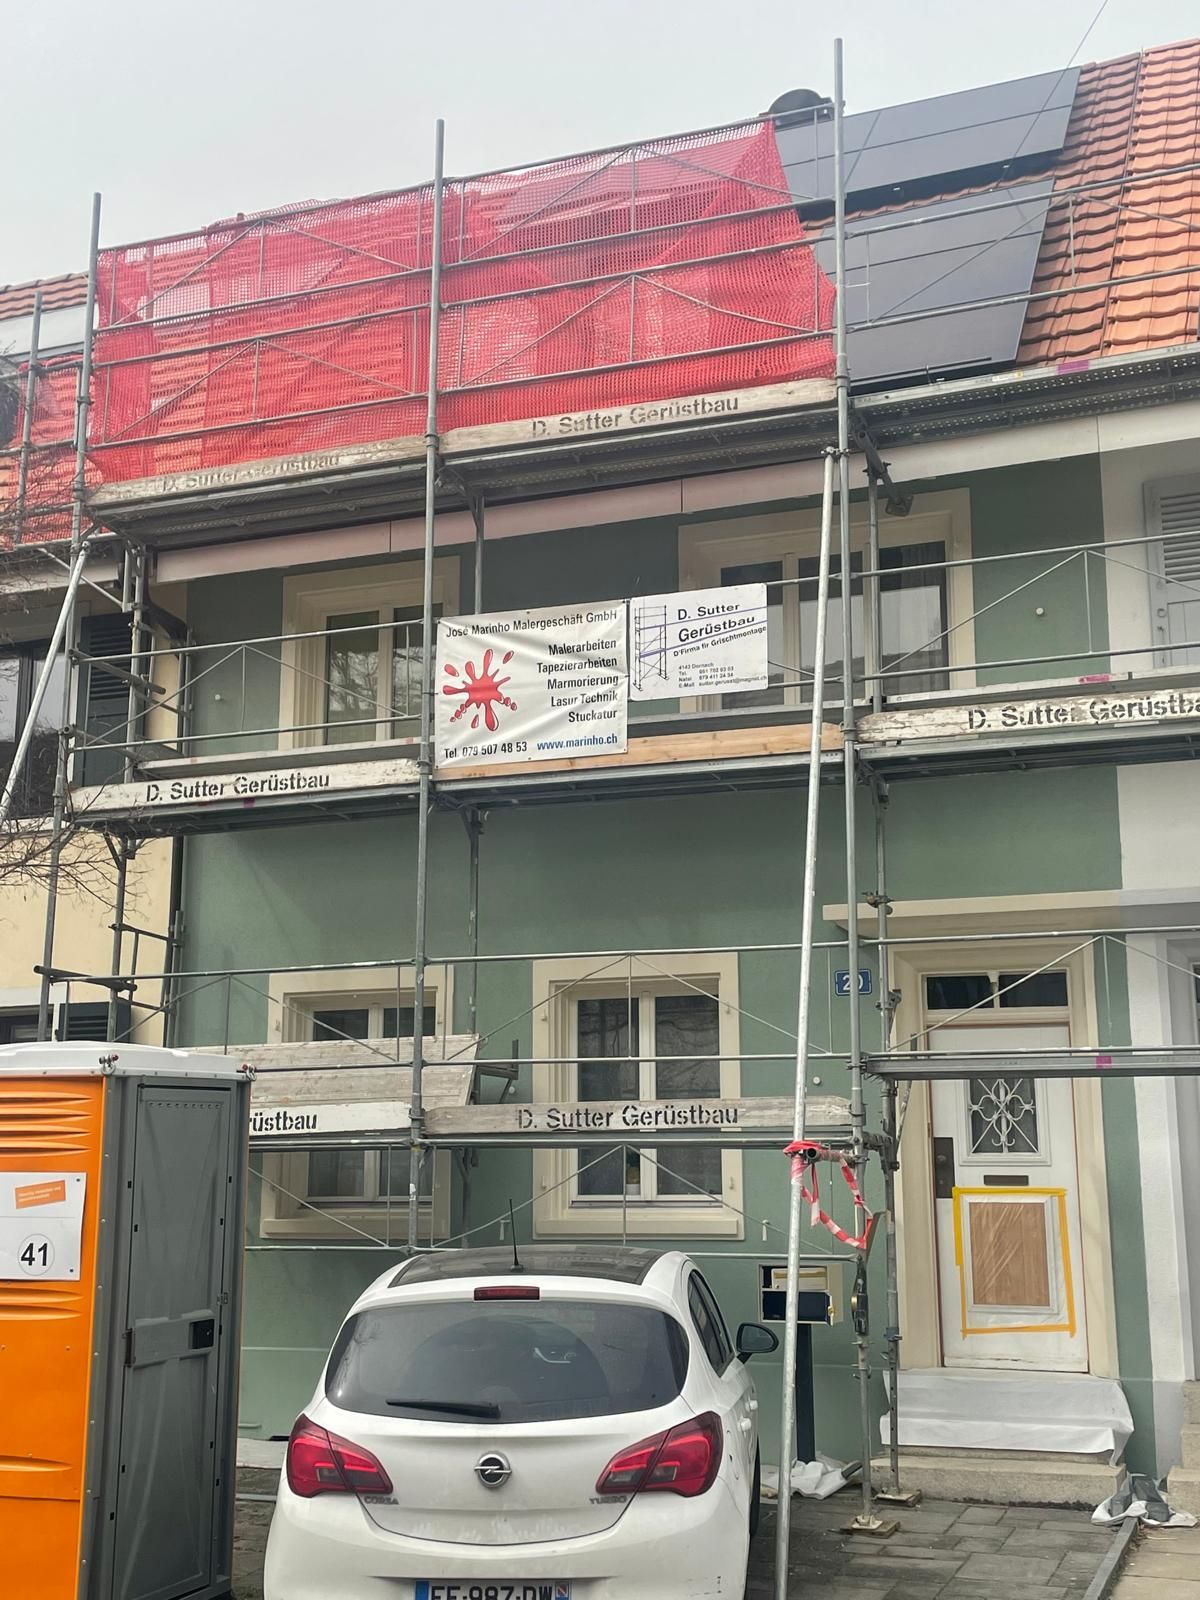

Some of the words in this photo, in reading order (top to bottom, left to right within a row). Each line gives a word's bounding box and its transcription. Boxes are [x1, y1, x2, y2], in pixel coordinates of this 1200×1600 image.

[532, 419, 550, 438] D.
[559, 412, 622, 434] Sutter
[630, 397, 738, 424] Gerüstbau
[678, 608, 691, 620] D.
[697, 604, 740, 617] Sutter
[471, 622, 510, 635] Marinho
[513, 613, 583, 632] Malergeschäft
[586, 612, 617, 624] GmbH
[678, 616, 755, 642] Gerüstbau
[548, 639, 617, 656] Malerarbeiten
[537, 657, 618, 675] Tapezierarbeiten
[547, 674, 619, 690] Marmorierung
[551, 697, 578, 708] Lasur
[580, 690, 618, 705] Technik
[568, 710, 617, 723] Stuckatur
[968, 708, 991, 729] D.
[462, 746, 478, 757] 079
[481, 744, 497, 755] 507
[501, 743, 513, 753] 48
[516, 741, 528, 752] 53
[537, 732, 618, 750] www.marinho.ch
[146, 784, 163, 802] D.
[170, 780, 225, 800] Sutter
[233, 772, 330, 795] Gerüstbau
[517, 1109, 537, 1129] D.
[546, 1107, 613, 1128] Sutter
[622, 1104, 738, 1127] Gerüstbau
[20, 1242, 48, 1266] 41
